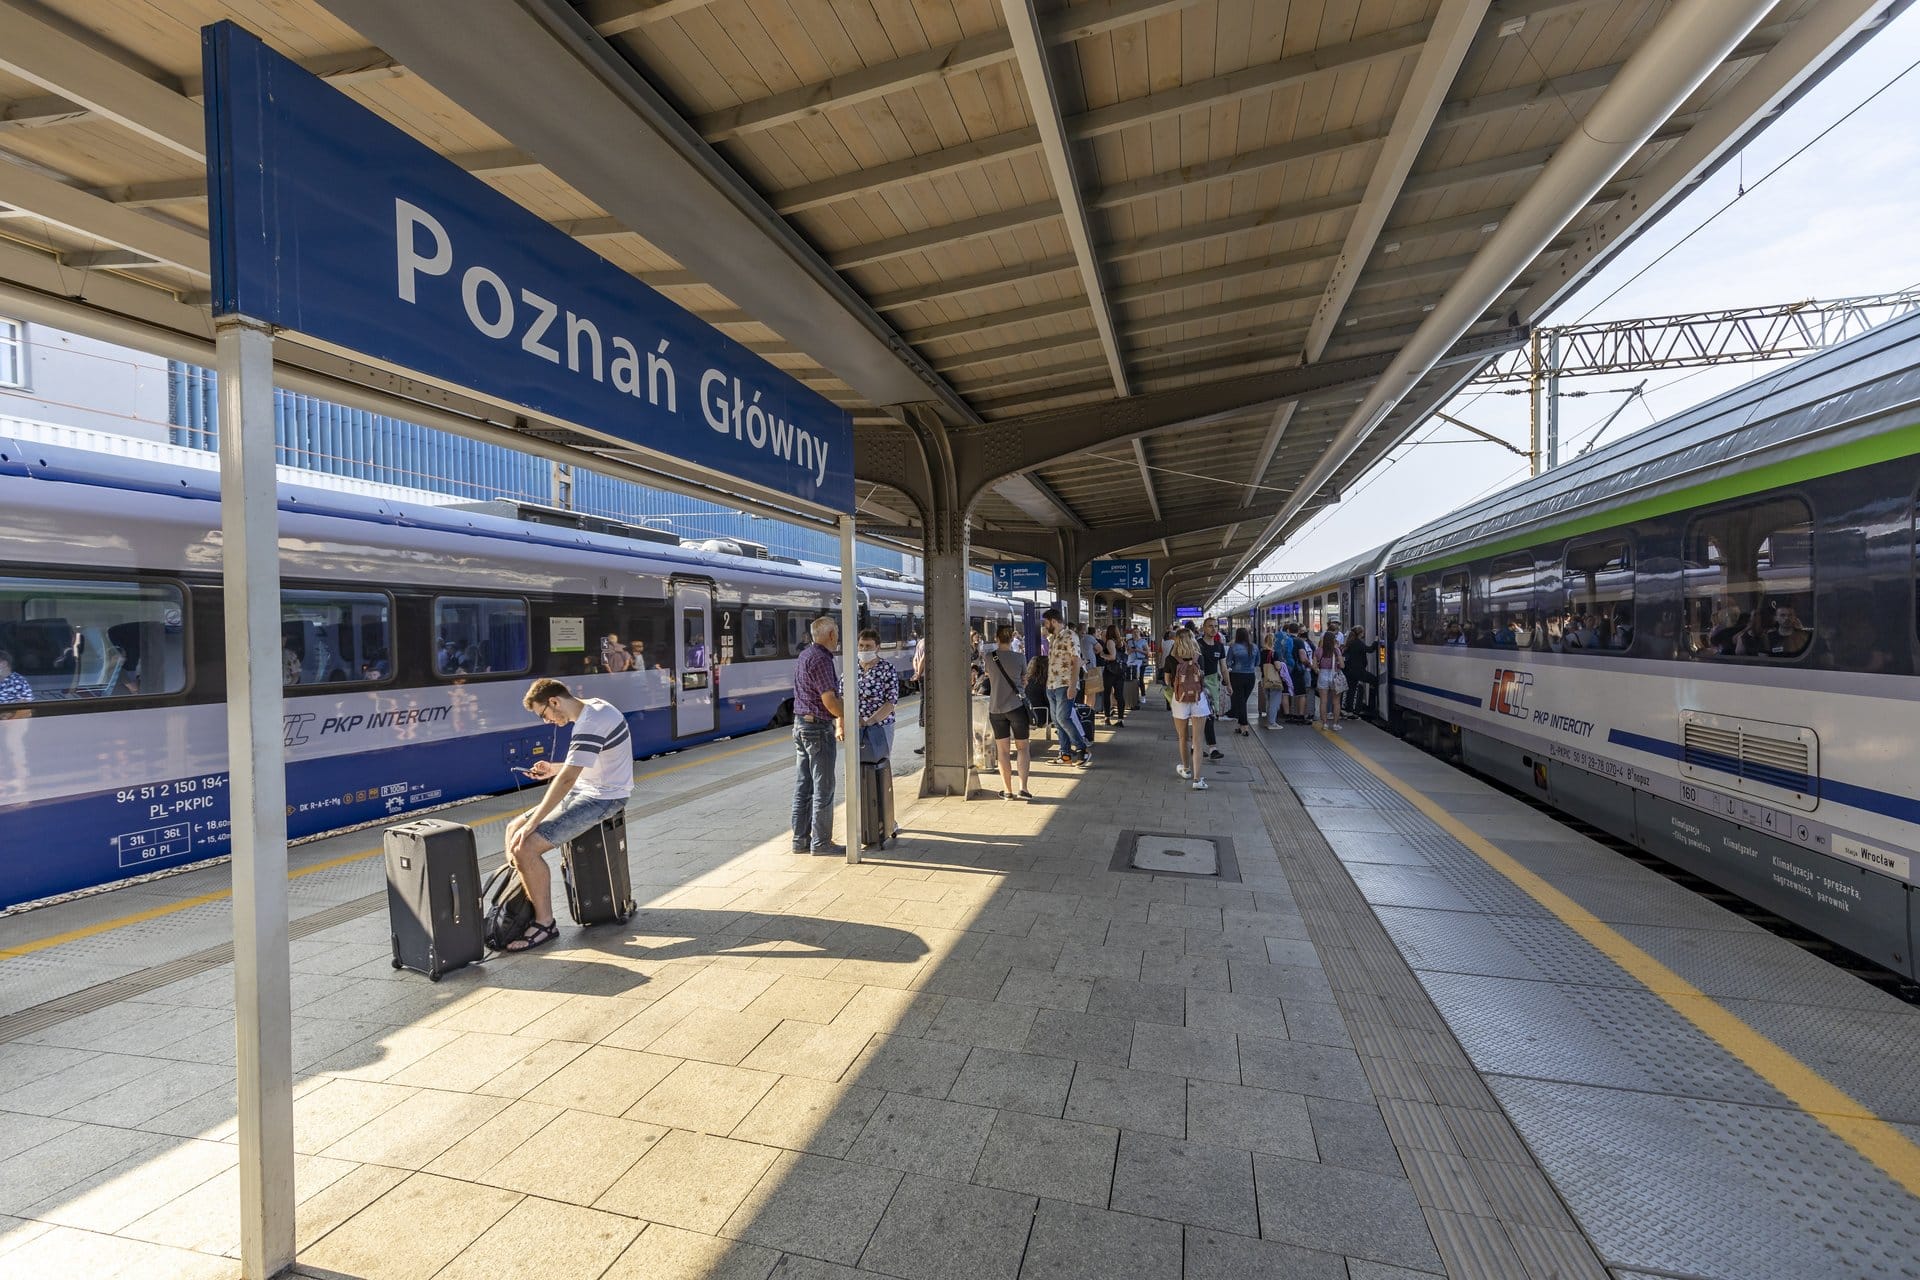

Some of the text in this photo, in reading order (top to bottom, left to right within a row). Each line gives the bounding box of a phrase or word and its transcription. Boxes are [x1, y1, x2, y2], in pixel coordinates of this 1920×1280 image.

[396, 198, 829, 488] Poznań Główny
[1000, 568, 1006, 578] 5
[1134, 563, 1142, 573] 5
[997, 581, 1009, 590] 52
[1132, 576, 1145, 586] 54
[1400, 580, 1408, 611] 2
[723, 611, 731, 630] 2
[320, 714, 364, 735] PKP
[366, 704, 453, 729] INTERCITY
[1532, 709, 1595, 738] PKP INTERCITY
[116, 776, 229, 804] 94 51 2 150 194-
[1682, 785, 1697, 802] 160
[149, 795, 214, 818] PL-PKPIC
[1765, 812, 1772, 827] 4
[130, 834, 146, 847] 31t
[163, 828, 181, 840] 36t
[141, 847, 156, 859] 60
[1723, 836, 1759, 858] Klimatyzator
[1860, 847, 1895, 869] Wrocław
[1772, 855, 1814, 882] Klimatyzacja
[1817, 891, 1850, 912] parownik
